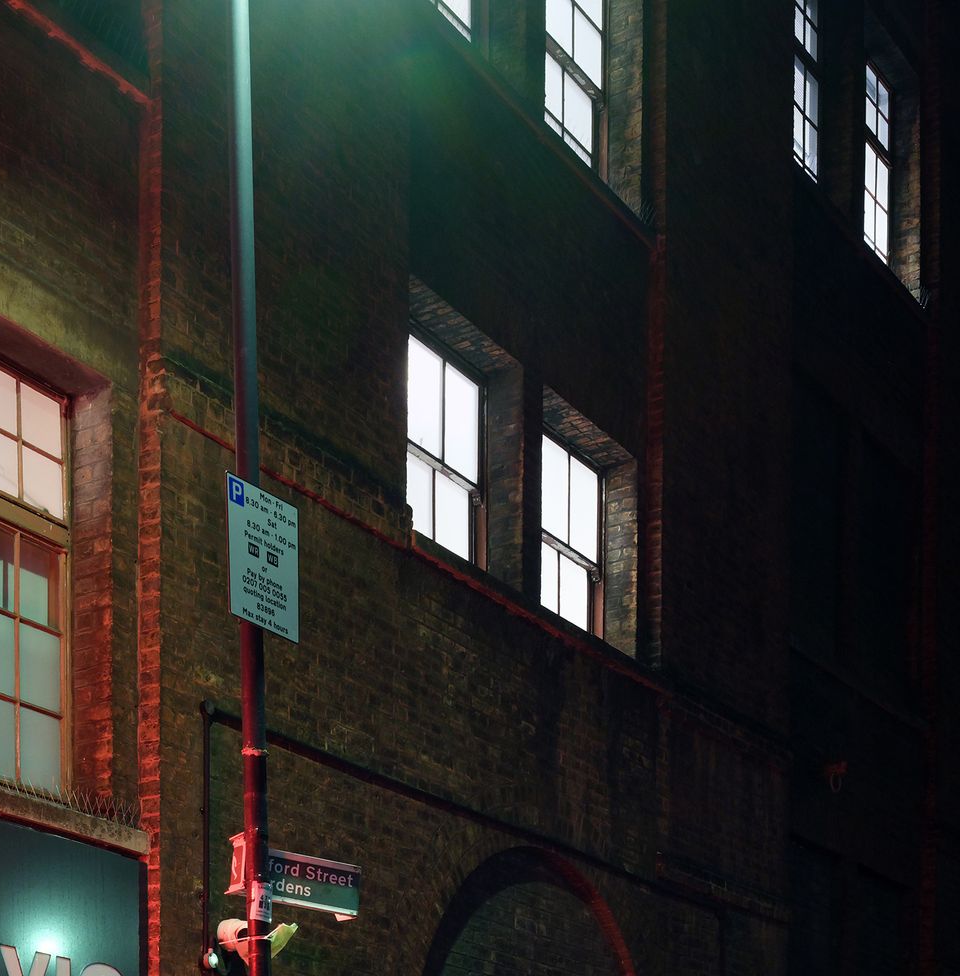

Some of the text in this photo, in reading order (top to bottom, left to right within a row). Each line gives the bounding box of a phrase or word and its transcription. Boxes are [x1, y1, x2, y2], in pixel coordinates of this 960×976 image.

[232, 481, 242, 501] P
[260, 492, 272, 504] Mon
[246, 496, 259, 509] 8.30
[260, 506, 268, 514] am
[274, 511, 286, 523] 6.30
[288, 520, 296, 528] pm
[267, 518, 277, 529] Sat
[244, 530, 284, 556] Permit holders
[247, 520, 260, 532] 8.30
[275, 534, 286, 545] 1.00
[288, 542, 296, 550] pm
[242, 575, 257, 587] 0207
[259, 583, 270, 594] 005
[247, 568, 282, 590] Pay by phone
[243, 586, 286, 611] quoting location
[243, 607, 254, 618] Max
[256, 615, 266, 625] stay
[274, 621, 288, 634] hours
[268, 859, 354, 888] ford Street
[270, 878, 311, 896] rdens
